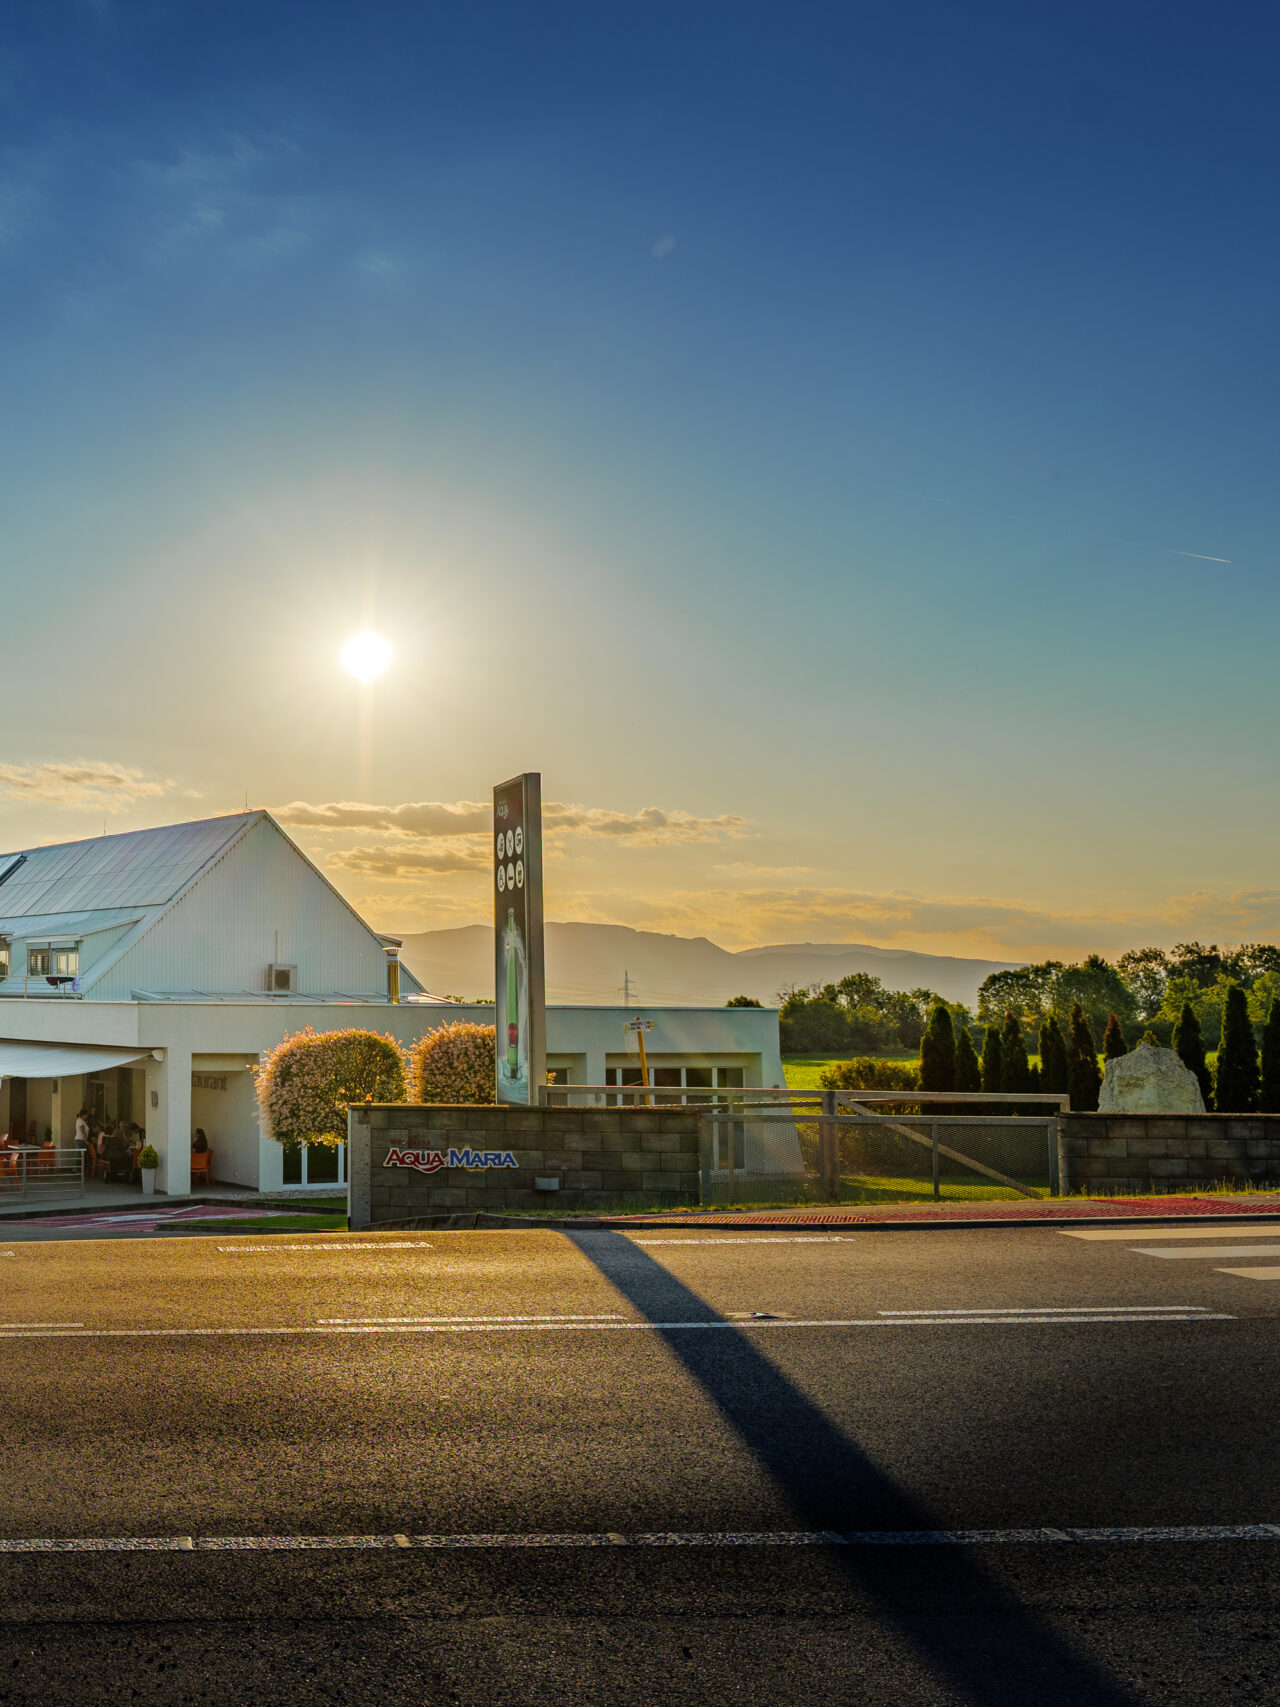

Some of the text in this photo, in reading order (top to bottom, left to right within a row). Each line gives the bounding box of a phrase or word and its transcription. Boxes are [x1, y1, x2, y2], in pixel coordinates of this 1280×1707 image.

[191, 1074, 227, 1091] aurant
[384, 1148, 519, 1173] AQUA MARIA
